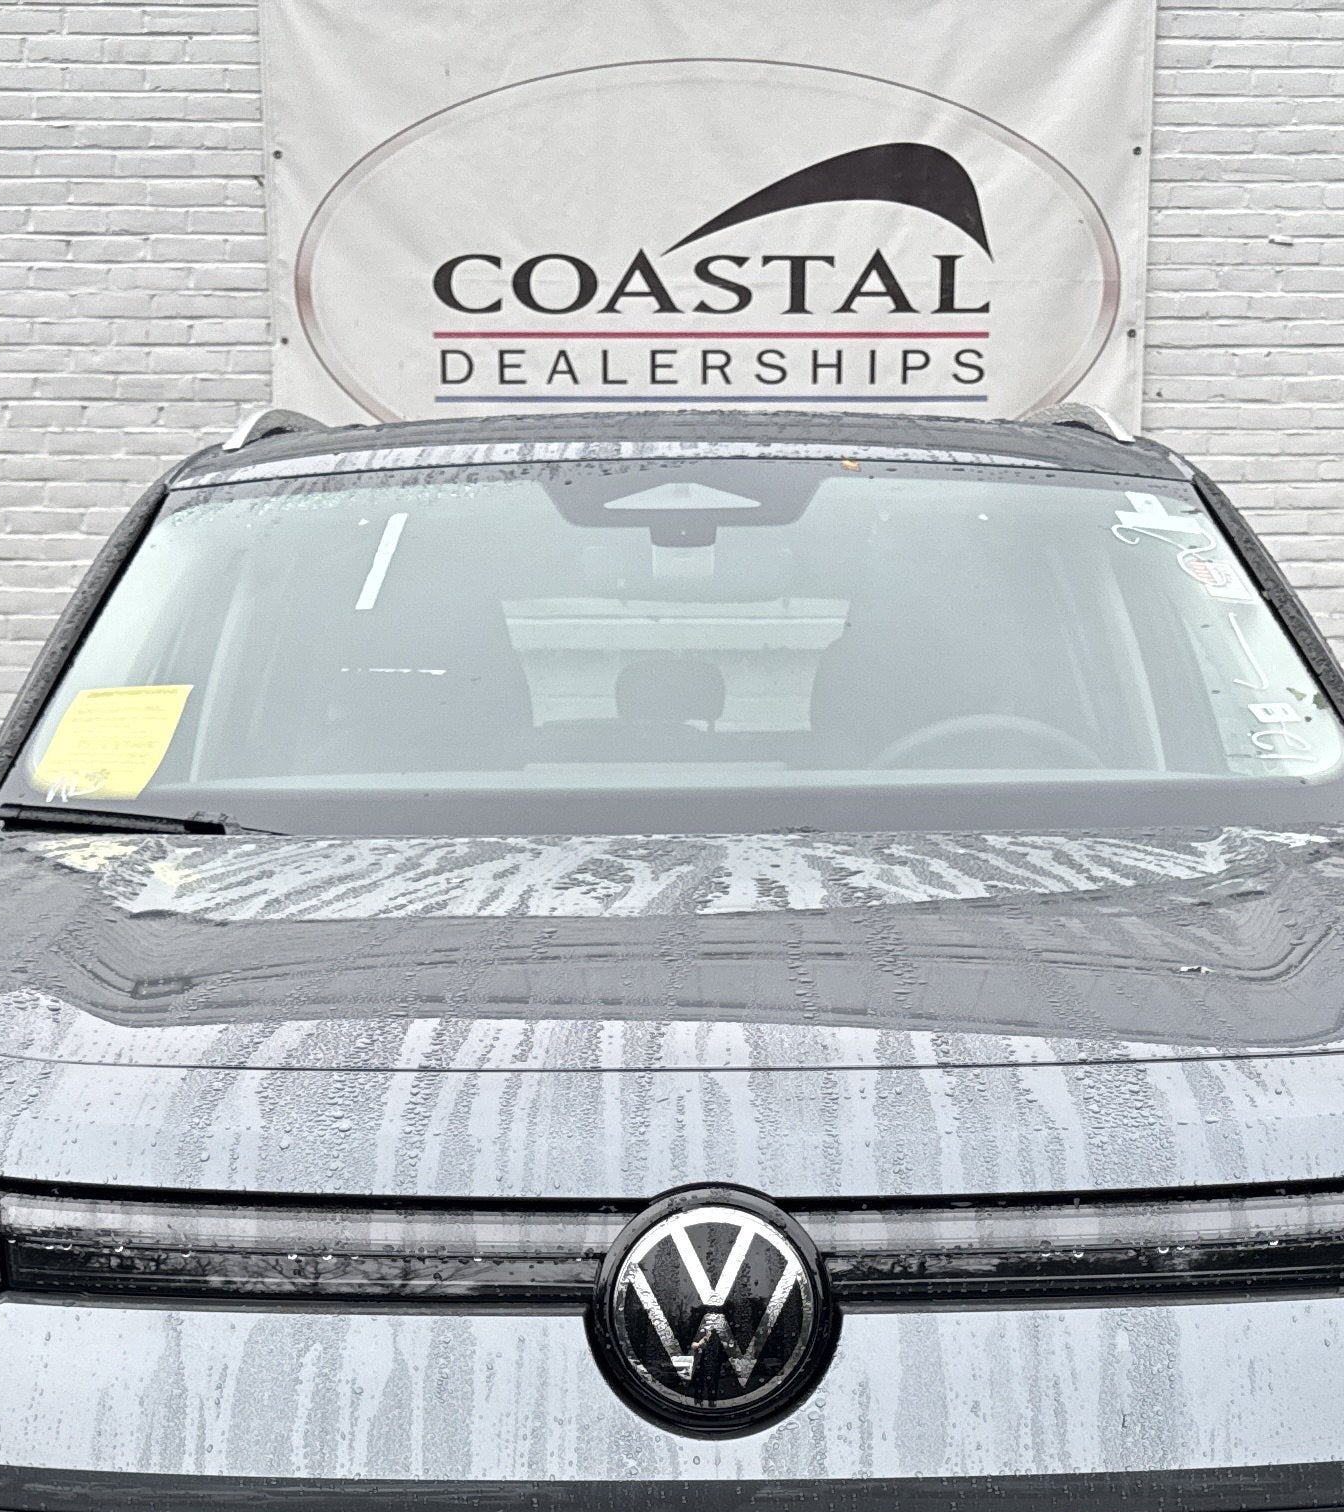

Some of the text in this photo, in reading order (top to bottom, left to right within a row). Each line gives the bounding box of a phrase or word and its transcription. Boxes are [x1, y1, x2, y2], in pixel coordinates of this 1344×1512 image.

[433, 248, 991, 315] COASTAL
[440, 348, 987, 386] DEALERSHIPS
[618, 1210, 806, 1396] VW
